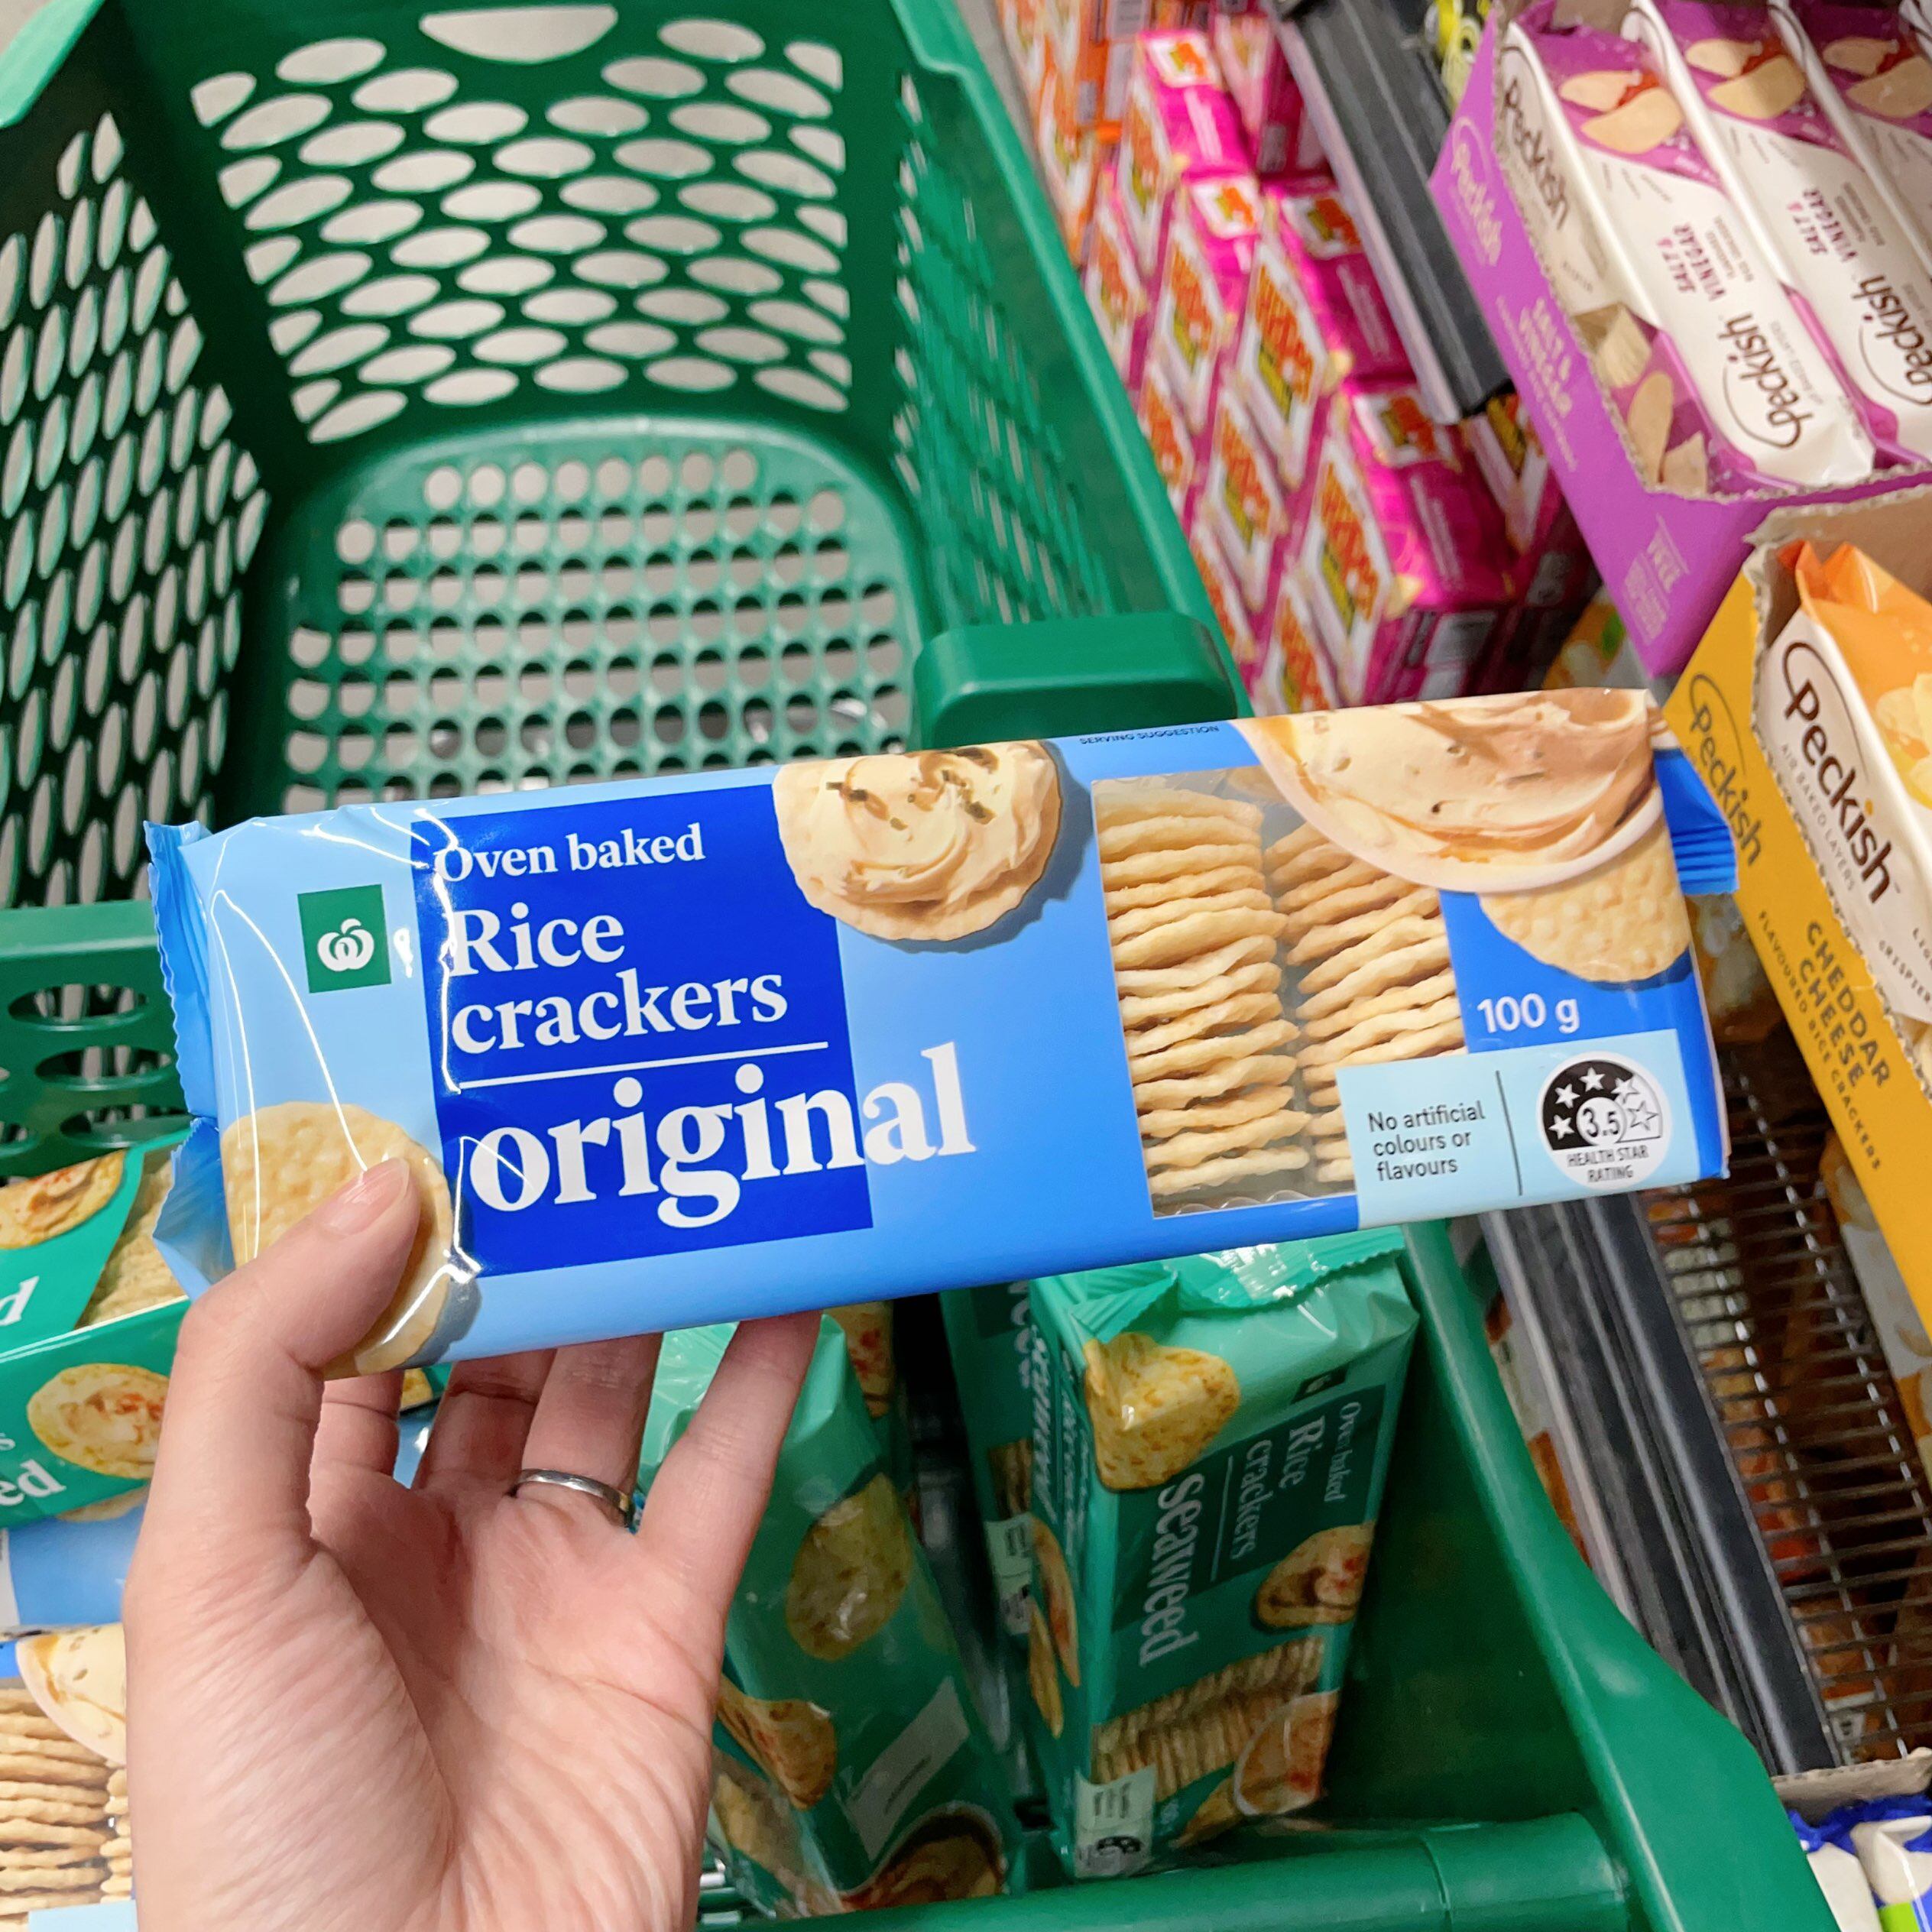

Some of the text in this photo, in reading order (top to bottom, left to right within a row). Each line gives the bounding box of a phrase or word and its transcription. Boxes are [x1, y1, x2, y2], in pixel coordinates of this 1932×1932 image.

[1852, 274, 1932, 405] Peckish
[1718, 312, 1814, 449] Peckish
[1079, 724, 1220, 745] SERVING SUGGESTION
[1690, 673, 1763, 868] Peckish
[1783, 642, 1897, 905] Peckish
[433, 822, 706, 883] Oven baked
[448, 902, 625, 977] Rice
[452, 968, 788, 1055] crackers
[1477, 993, 1580, 1034] 100 g
[1759, 910, 1882, 1170] FLAVOURED RICE CRACKERS
[1799, 959, 1865, 1088] CHEESE
[1807, 921, 1891, 1088] CHEDDAR
[468, 1042, 976, 1229] original
[1368, 1101, 1486, 1133] No artificial
[1373, 1132, 1472, 1157] colours or
[1567, 1145, 1649, 1167] HEALTH STAR
[1582, 1107, 1621, 1138] 3.5
[1377, 1157, 1458, 1182] flavours
[1587, 1165, 1635, 1183] RATING
[1279, 1415, 1326, 1489] Rice
[1230, 1439, 1273, 1561] crackers
[1139, 1473, 1207, 1667] seaweed
